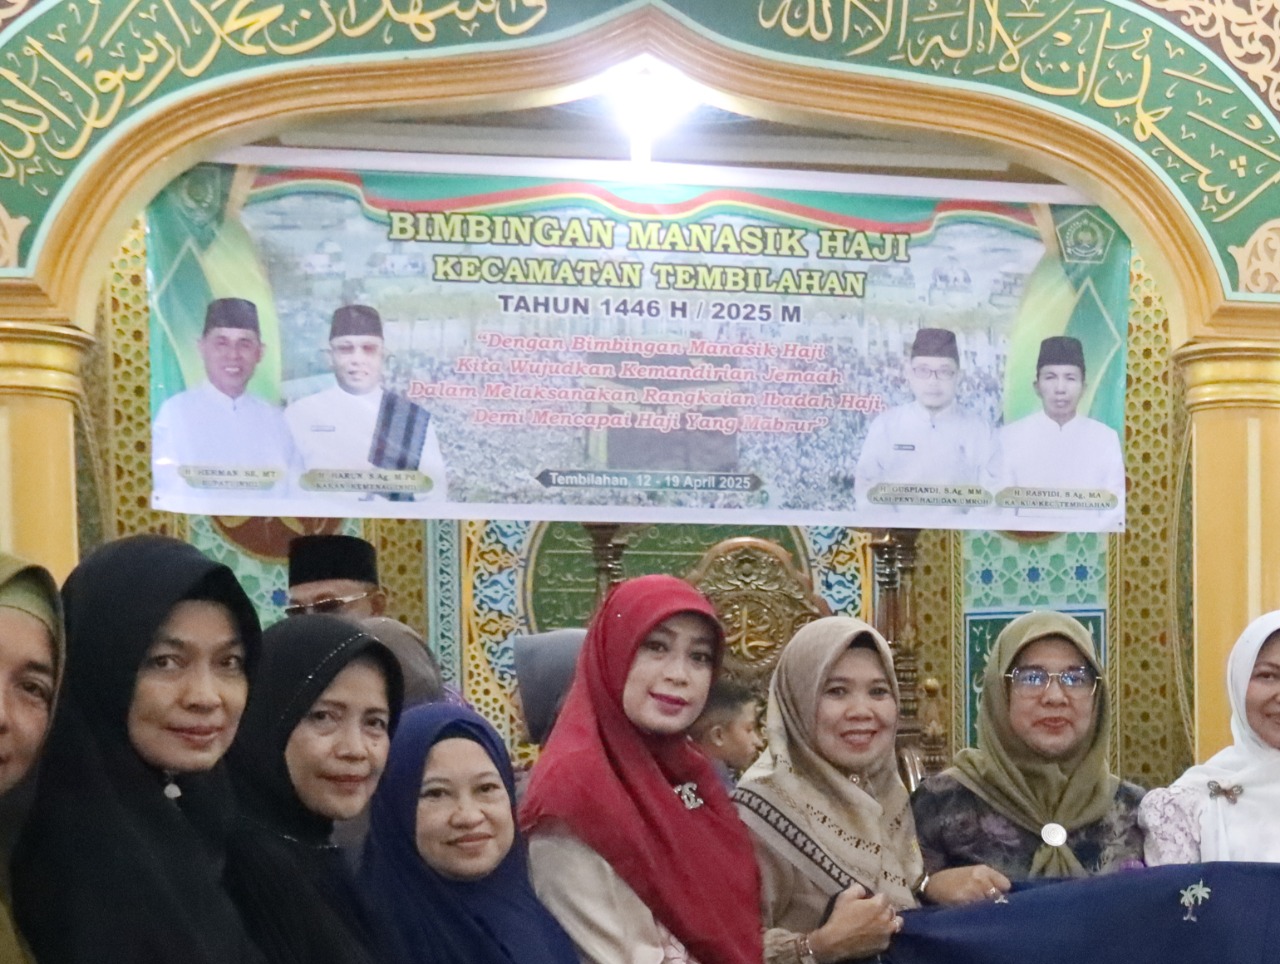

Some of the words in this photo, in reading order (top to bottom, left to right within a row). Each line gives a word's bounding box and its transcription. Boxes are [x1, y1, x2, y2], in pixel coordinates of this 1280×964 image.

[388, 211, 616, 249] BIMBINGAN
[626, 222, 808, 257] MANASIK
[817, 230, 910, 262] HAJI
[432, 255, 643, 288] KECAMATAN
[651, 264, 867, 297] TEMBILAHAN
[499, 295, 590, 315] TAHUN
[601, 299, 660, 318] 1446
[670, 301, 687, 318] H
[711, 303, 772, 321] 2025
[781, 306, 801, 323] M
[572, 336, 683, 358] Bimbingan
[689, 340, 776, 358] Manasik
[781, 343, 826, 362] Haji
[456, 358, 501, 374] Kita
[510, 360, 615, 379] Wujudkan
[620, 363, 756, 382] Kemandirian
[761, 368, 843, 385] Jemaah
[410, 381, 477, 397] Dalam
[484, 383, 637, 402] Melaksanakan
[643, 388, 756, 408] Rangkaian
[763, 392, 834, 410] Ibadah
[474, 408, 524, 424] Demi
[532, 410, 632, 430] Mencapai
[637, 413, 680, 433] Haji
[686, 414, 738, 433] Yang
[637, 475, 651, 487] 12
[665, 476, 679, 488] 19
[683, 475, 715, 491] April
[720, 477, 750, 490] 2025
